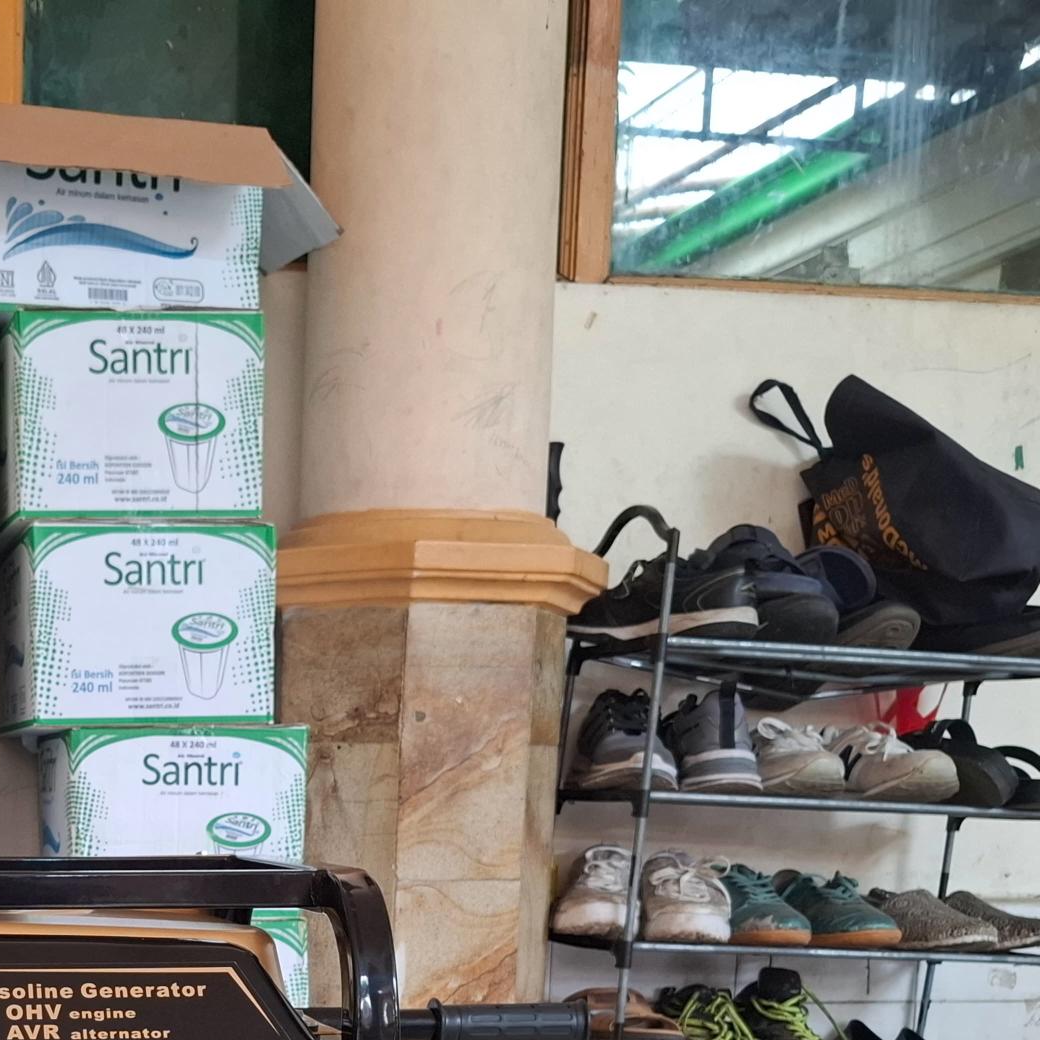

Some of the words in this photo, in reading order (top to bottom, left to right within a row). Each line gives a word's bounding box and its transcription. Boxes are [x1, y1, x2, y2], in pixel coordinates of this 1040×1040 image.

[137, 326, 152, 334] 240
[154, 326, 165, 334] ml
[89, 337, 190, 375] Santri
[69, 461, 99, 470] Bersih
[57, 473, 80, 484] 240
[83, 473, 99, 484] ml
[151, 538, 166, 546] 240
[104, 551, 203, 586] Santri
[84, 670, 114, 679] Bersih
[72, 682, 94, 693] 240
[97, 681, 113, 693] ml
[142, 752, 241, 786] Santri
[80, 982, 207, 999] Generator
[5, 1003, 62, 1020] OHV
[68, 1008, 136, 1022] engine
[7, 1024, 60, 1040] AVR
[70, 1028, 171, 1040] alternator
